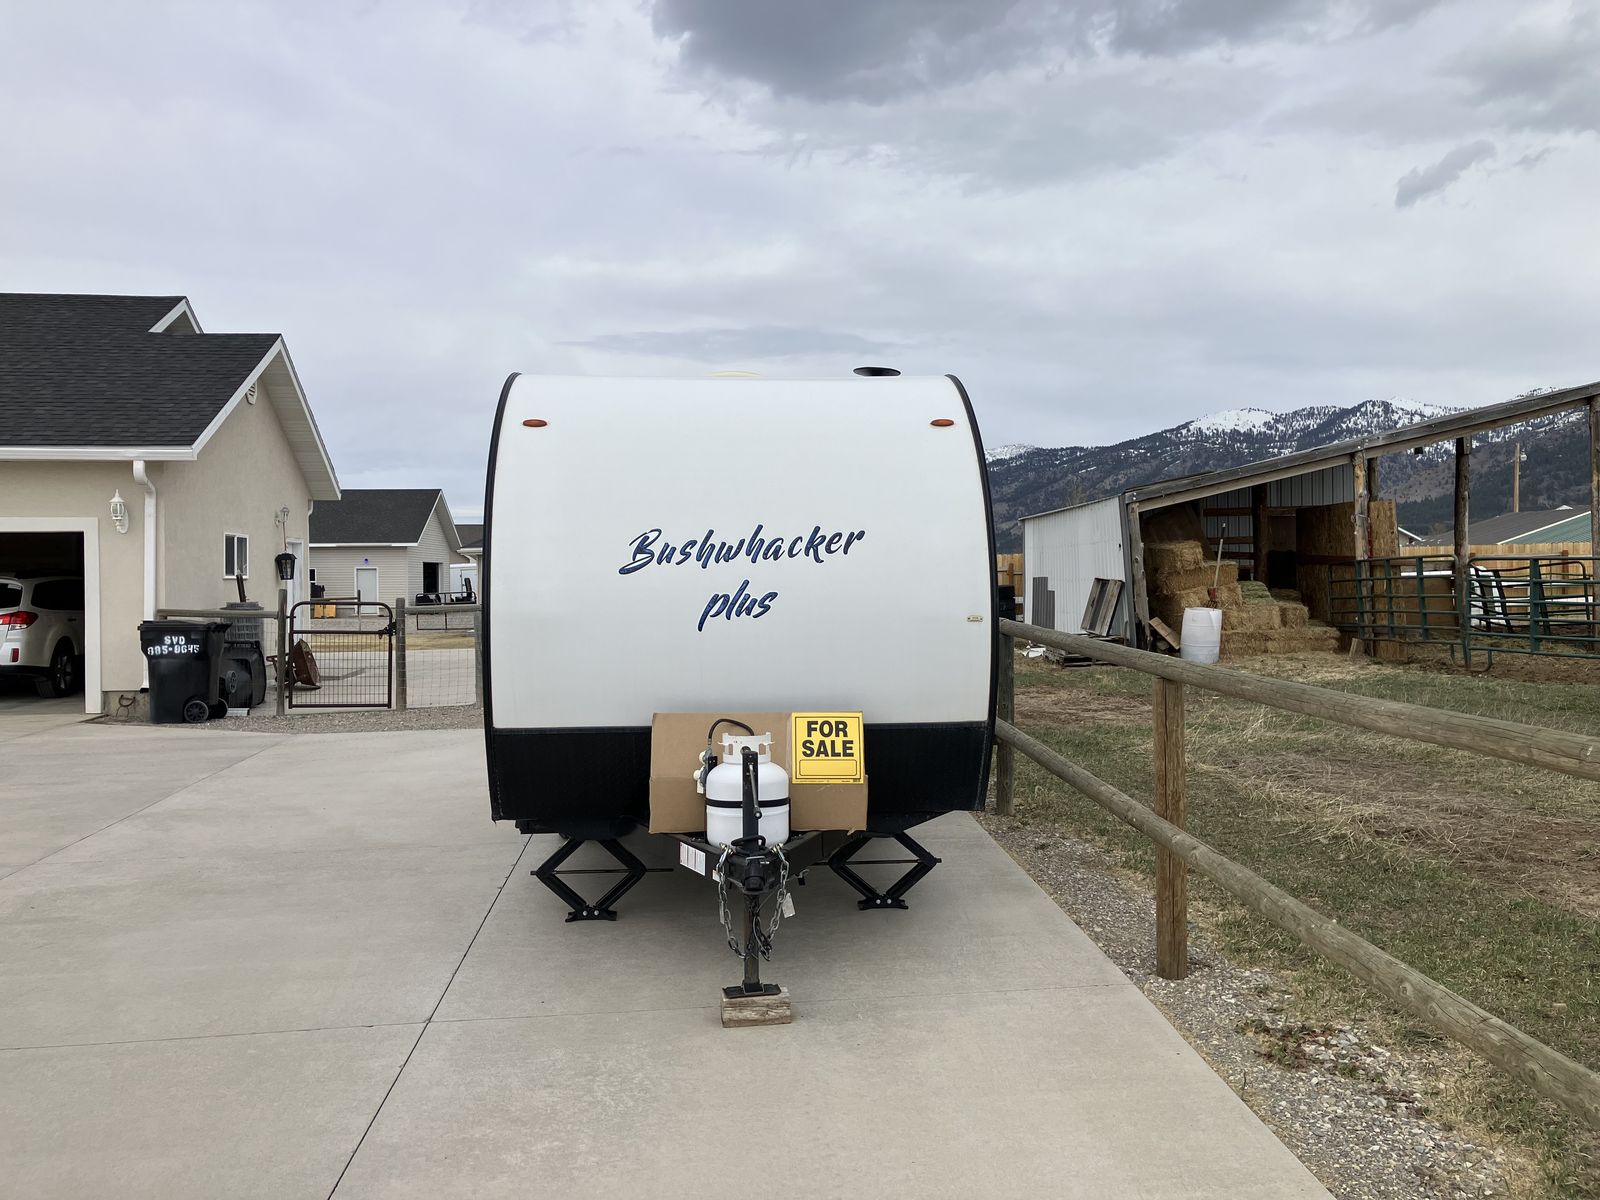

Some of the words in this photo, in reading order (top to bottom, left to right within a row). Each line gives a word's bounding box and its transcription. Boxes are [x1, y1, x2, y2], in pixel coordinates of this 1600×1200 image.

[618, 524, 866, 575] Bushwhacker
[697, 579, 779, 632] plus
[164, 635, 186, 645] SVD
[806, 720, 849, 738] FOR
[801, 739, 855, 758] SALE
